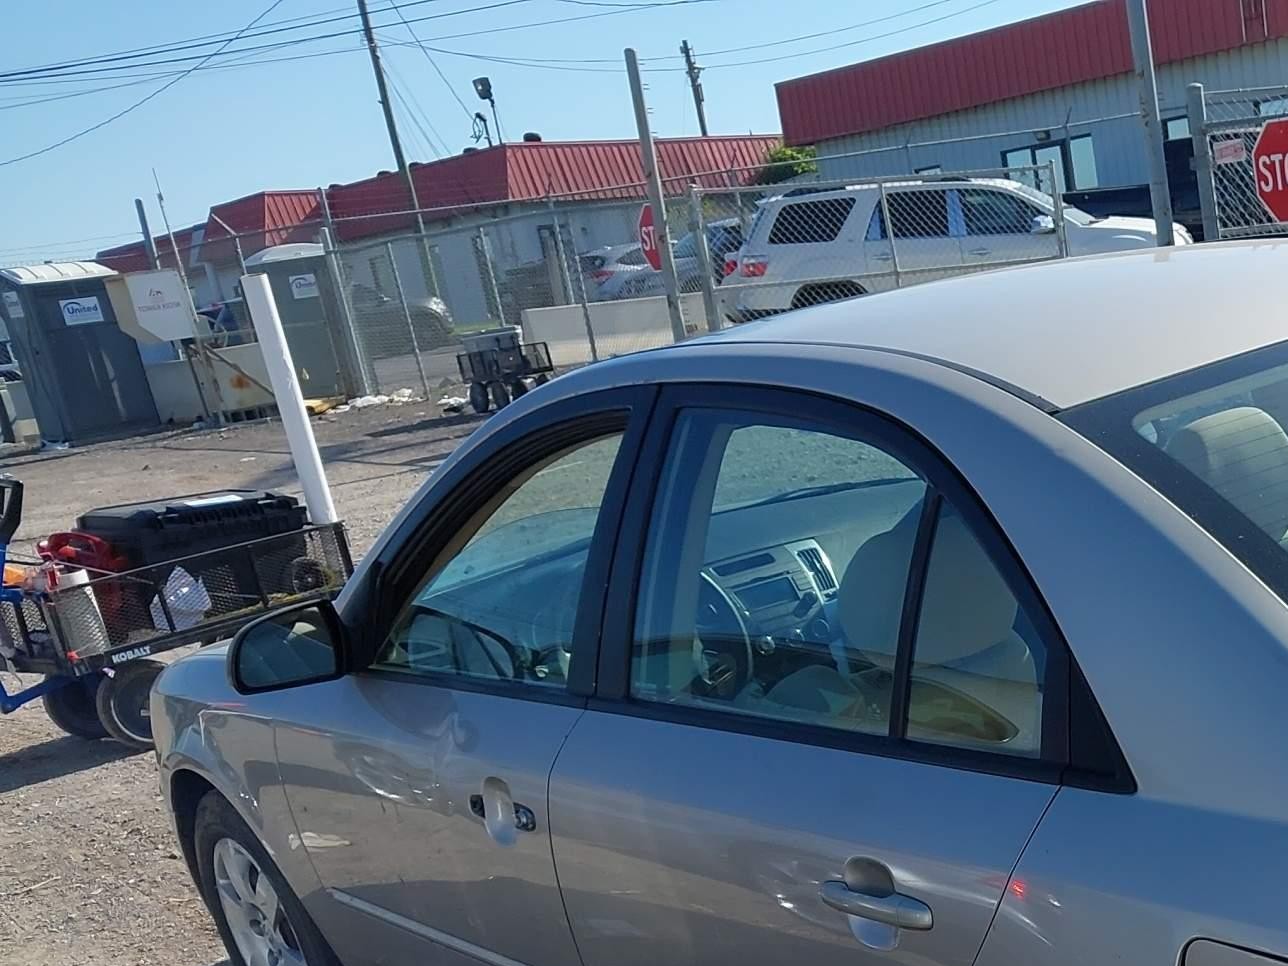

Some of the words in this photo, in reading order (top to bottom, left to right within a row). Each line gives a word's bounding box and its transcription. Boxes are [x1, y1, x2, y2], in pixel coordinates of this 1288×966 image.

[641, 226, 656, 251] ST
[66, 303, 98, 315] United
[112, 645, 151, 664] KOBALT
